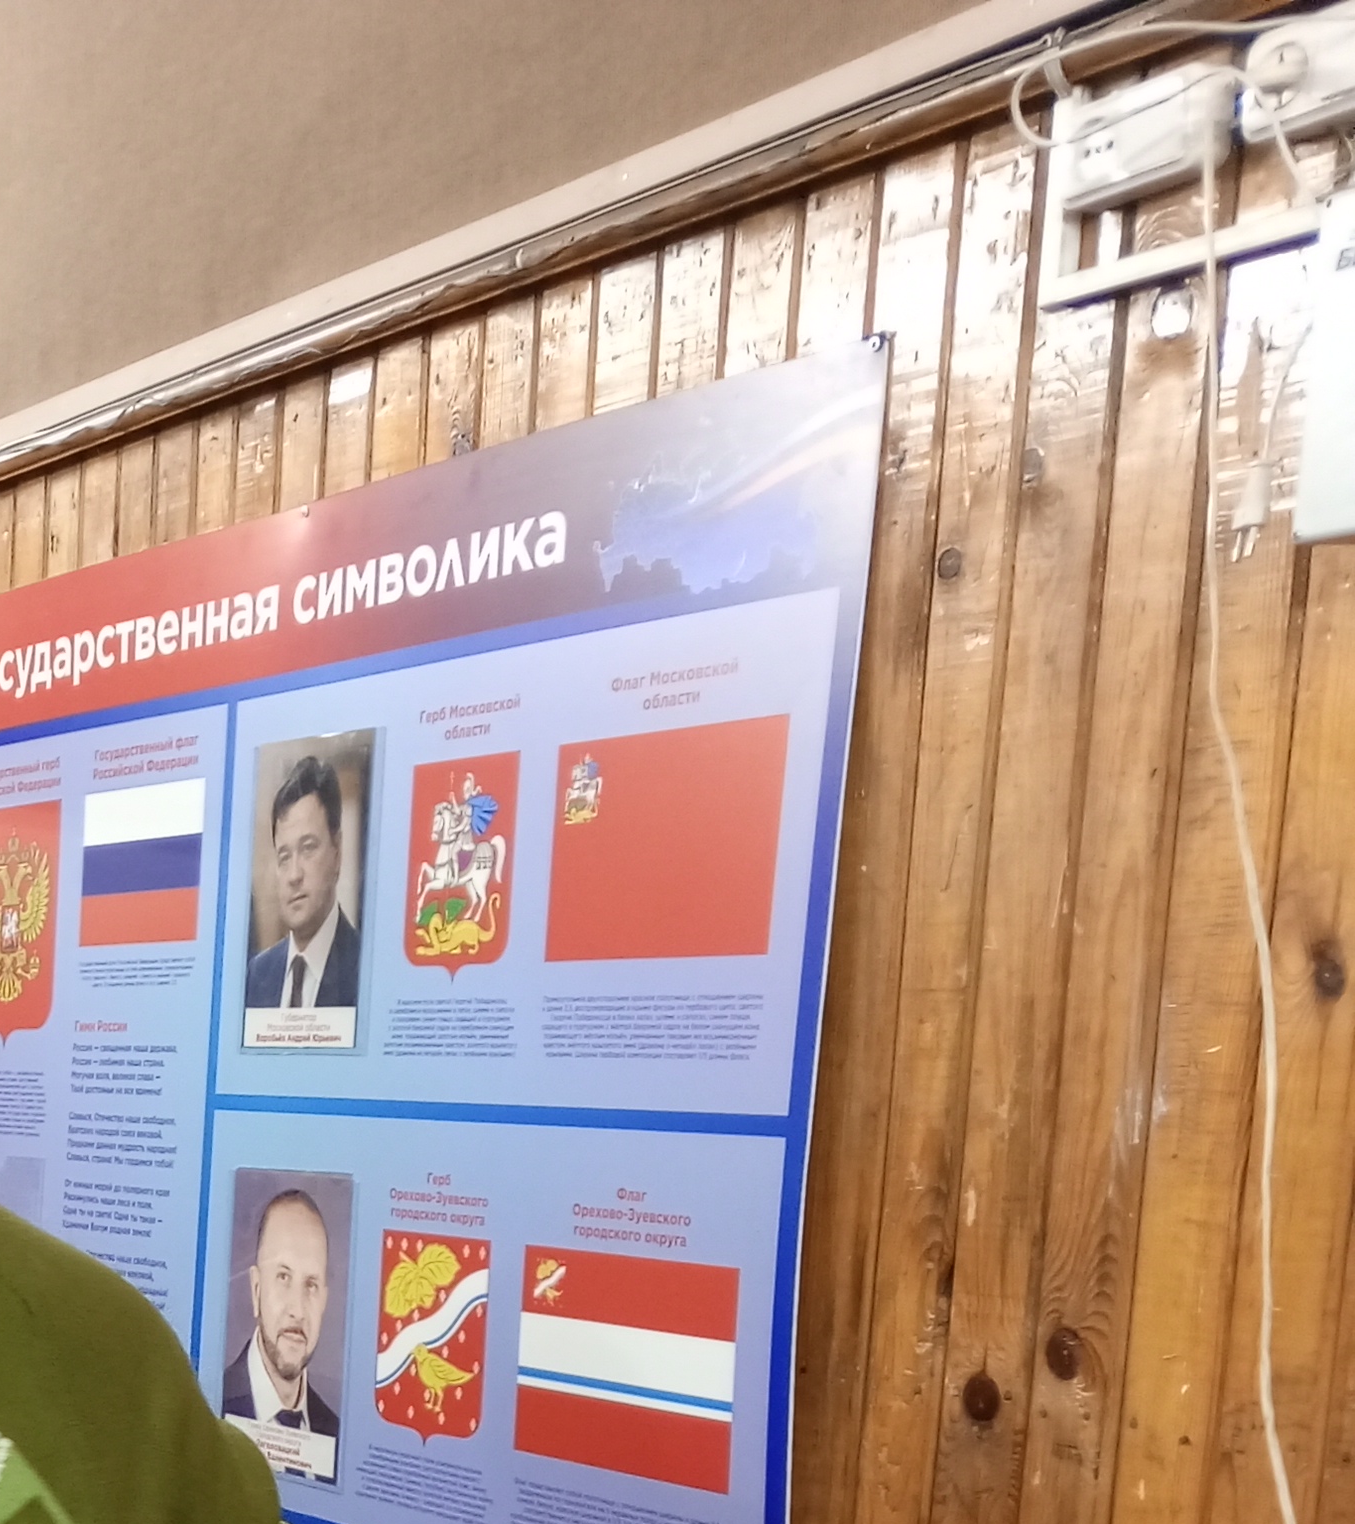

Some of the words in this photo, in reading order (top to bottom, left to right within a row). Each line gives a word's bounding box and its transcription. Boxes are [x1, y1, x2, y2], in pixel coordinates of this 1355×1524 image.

[292, 510, 567, 625] символика
[611, 675, 646, 693] Флаг
[649, 658, 739, 686] Московской
[419, 706, 446, 724] Герб
[449, 694, 521, 720] Московской
[643, 690, 701, 711] области
[444, 722, 490, 741] области
[94, 737, 173, 763] Государственный
[176, 734, 199, 753] флаг
[41, 756, 60, 773] герб
[93, 761, 145, 780] Российской
[146, 754, 199, 773] Федерации
[17, 776, 61, 794] Федерации
[97, 1020, 127, 1032] России
[426, 1171, 451, 1187] Герб
[390, 1187, 488, 1208] Орехово-Зуевского
[616, 1187, 647, 1202] Флаг
[390, 1207, 448, 1223] городского
[449, 1213, 485, 1227] округа
[572, 1203, 691, 1227] Орехово-Зуевского
[573, 1225, 641, 1242] городского
[644, 1231, 687, 1248] округа
